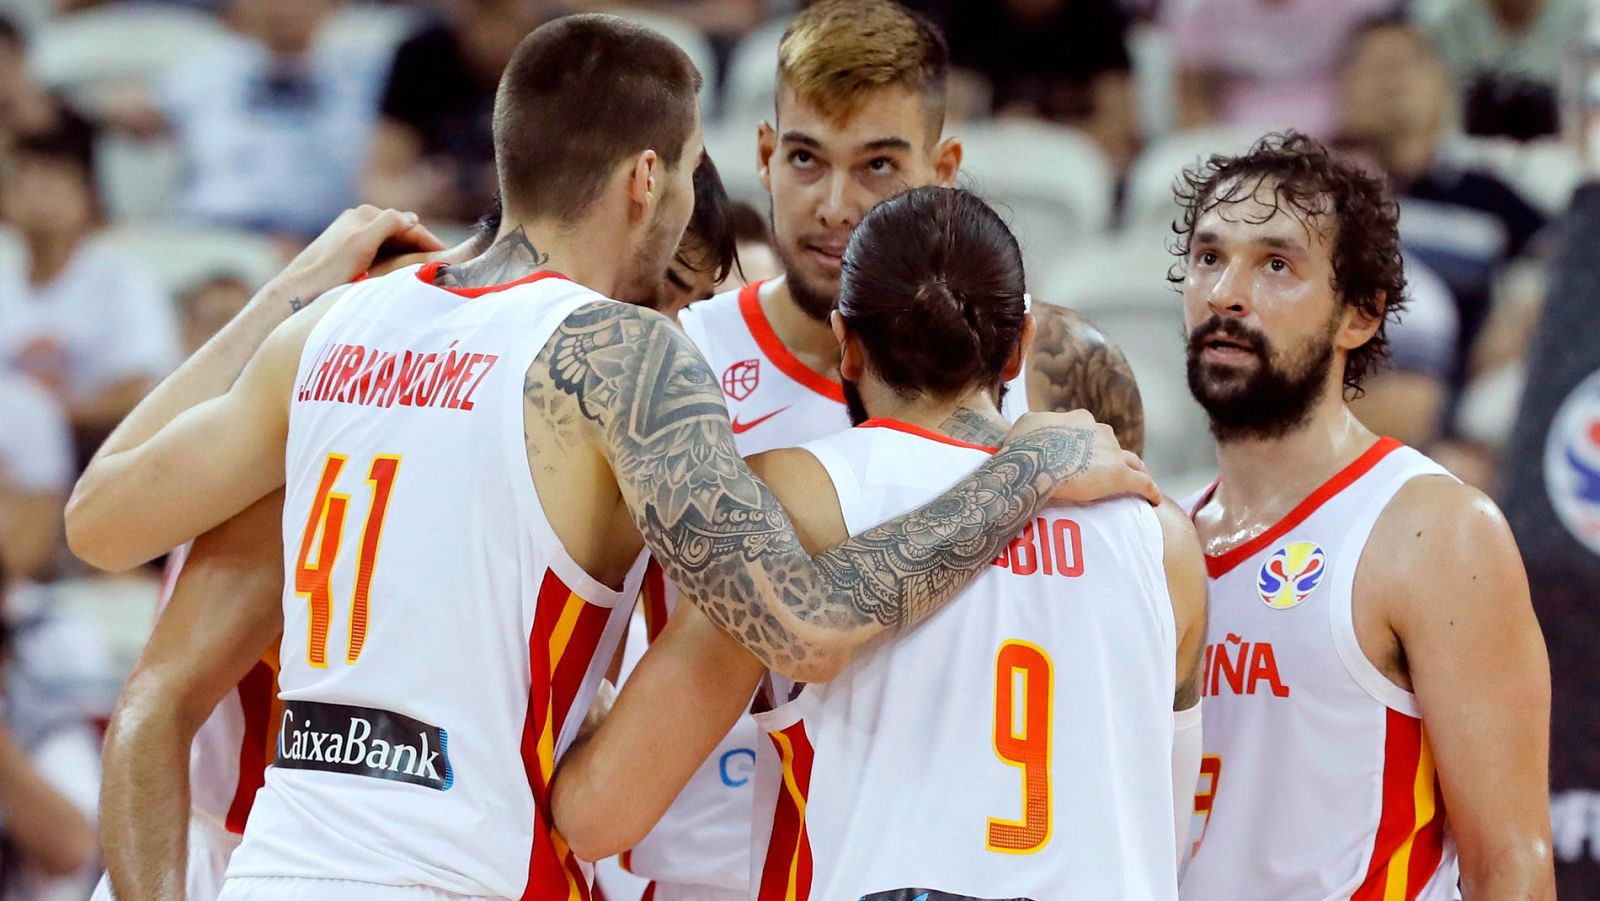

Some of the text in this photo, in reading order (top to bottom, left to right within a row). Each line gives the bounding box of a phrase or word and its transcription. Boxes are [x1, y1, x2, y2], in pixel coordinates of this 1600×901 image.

[295, 452, 404, 669] 41
[991, 516, 1085, 578] BIO
[280, 709, 441, 781] CaixaBank
[985, 638, 1056, 855] 9
